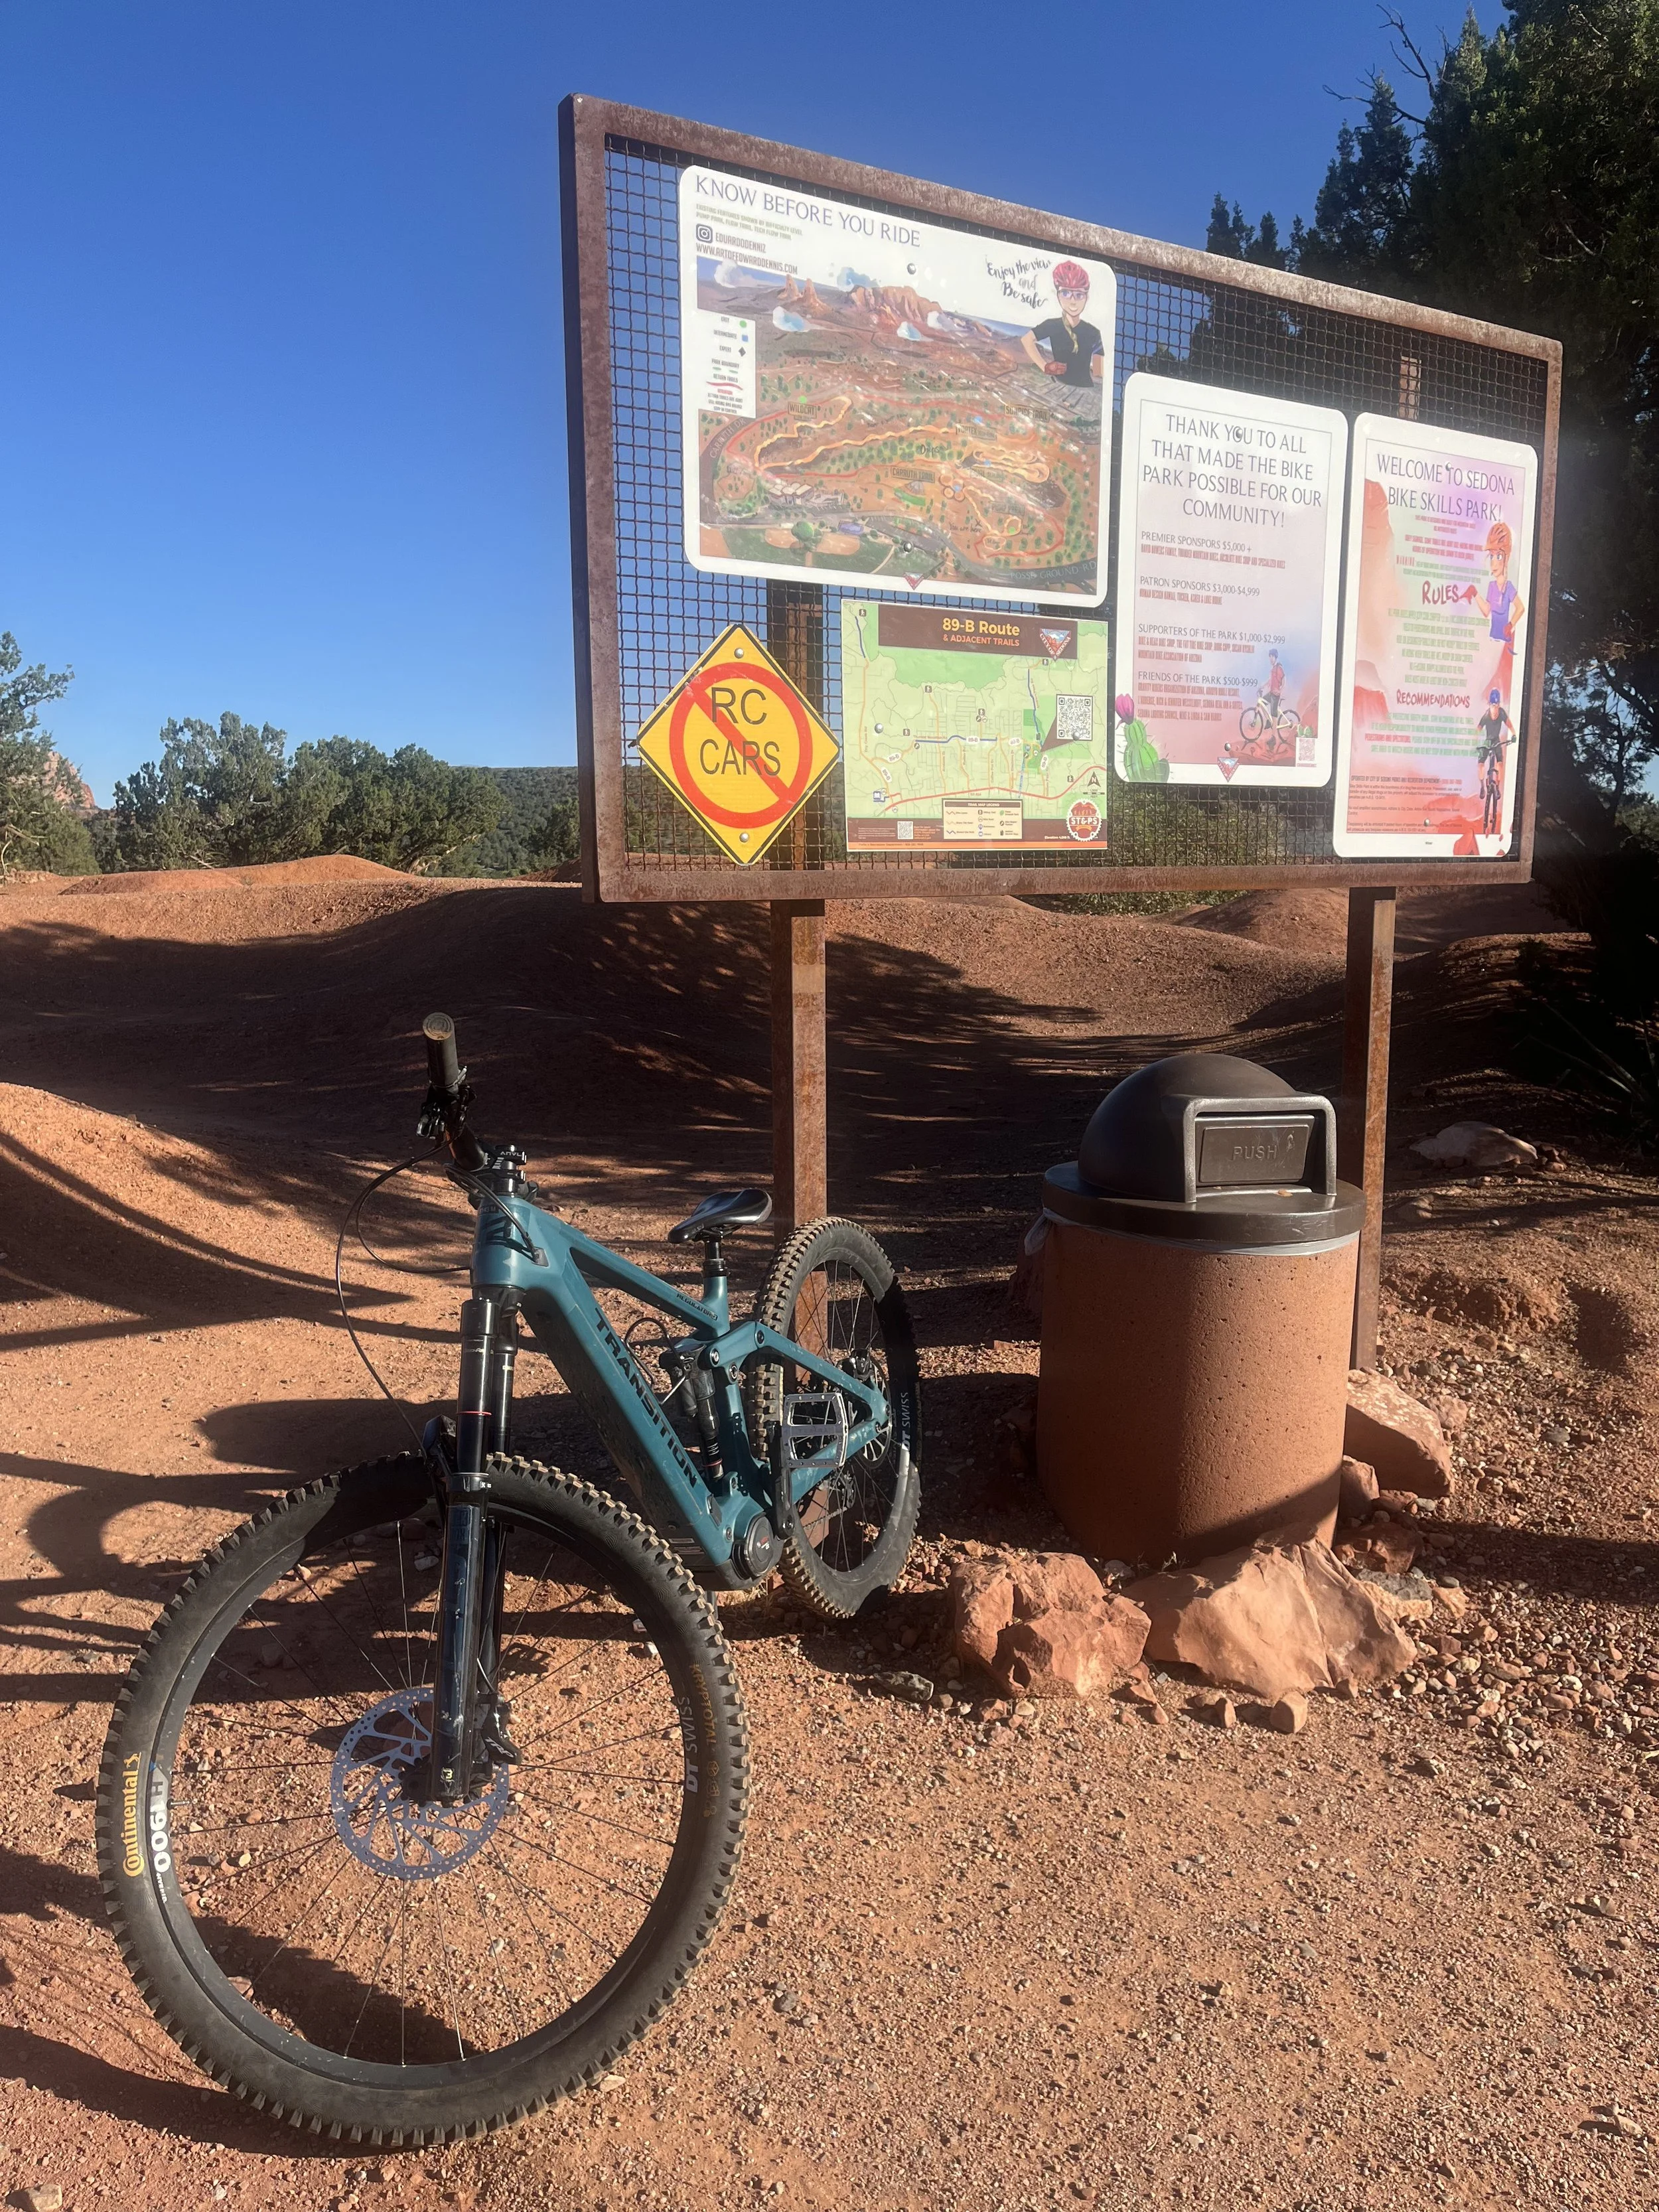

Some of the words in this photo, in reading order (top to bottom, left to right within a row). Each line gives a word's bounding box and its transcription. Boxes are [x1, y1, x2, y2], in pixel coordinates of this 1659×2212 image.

[697, 175, 757, 206] KNOW
[764, 192, 832, 227] BEFORE
[839, 212, 874, 236] YOU
[881, 222, 920, 247] RIDE
[987, 261, 1015, 280] Enjoy
[1015, 259, 1030, 275] the
[1031, 258, 1051, 270] view
[1019, 274, 1038, 291] and
[1001, 281, 1020, 299] Be
[1021, 292, 1048, 309] safe
[788, 403, 815, 415] WILDCAT
[709, 426, 734, 459] CARRUTH
[734, 417, 747, 429] DR
[1165, 413, 1220, 439] THANK
[1224, 423, 1254, 445] YOU
[1257, 429, 1275, 448] TO
[1279, 434, 1307, 454] ALL
[892, 467, 917, 479] CARRUTH
[1151, 439, 1194, 462] THAT
[1198, 446, 1244, 470] MADE
[1248, 455, 1277, 475] THE
[1281, 461, 1313, 480] BIKE
[1143, 465, 1183, 487] PARK
[1189, 471, 1256, 497] POSSIBLE
[1260, 482, 1287, 502] FOR
[1292, 487, 1322, 508] OUR
[1377, 453, 1443, 483] WELCOME
[1447, 467, 1463, 486] TO
[1466, 470, 1515, 495] SEDONA
[1183, 498, 1285, 528] COMMUNITY!
[1388, 486, 1417, 508] BIKE
[1420, 492, 1463, 516] SKILLS
[1466, 500, 1502, 522] PARK!
[1141, 531, 1176, 544] PREMIER
[1222, 541, 1246, 552] $5,000
[1040, 565, 1079, 579] GROUND
[1082, 560, 1097, 572] RD
[1140, 575, 1170, 587] PATRON
[1172, 579, 1211, 592] SPONSORS
[1212, 583, 1260, 597] $3,000-$4,999
[1422, 579, 1460, 605] RULES
[942, 617, 975, 632] 89-B
[979, 621, 1020, 636] Route
[950, 634, 991, 644] ADJACENT
[993, 638, 1020, 646] TRAILS
[1138, 623, 1187, 636] SUPPORTERS
[1189, 628, 1200, 637] OF
[1201, 629, 1216, 638] THE
[1218, 631, 1237, 640] PARK
[1239, 632, 1285, 644] $1,000-$2,999
[1040, 633, 1048, 648] CITY
[1138, 672, 1171, 682] FRIENDS
[1173, 673, 1184, 682] OF
[1185, 674, 1200, 684] THE
[1202, 676, 1221, 685] PARK
[1223, 677, 1258, 688] $500-$999
[711, 687, 767, 725] RC
[1396, 689, 1470, 708] RECOMMENDATIONS
[700, 739, 781, 776] CARS
[1232, 1145, 1277, 1161] PUSH
[595, 1307, 697, 1489] TRANSITION
[901, 1392, 910, 1428] SWISS
[678, 1696, 697, 1753] SWISS
[485, 1736, 515, 1758] TRP
[685, 1763, 699, 1793] DT
[121, 1770, 145, 1877] Continental
